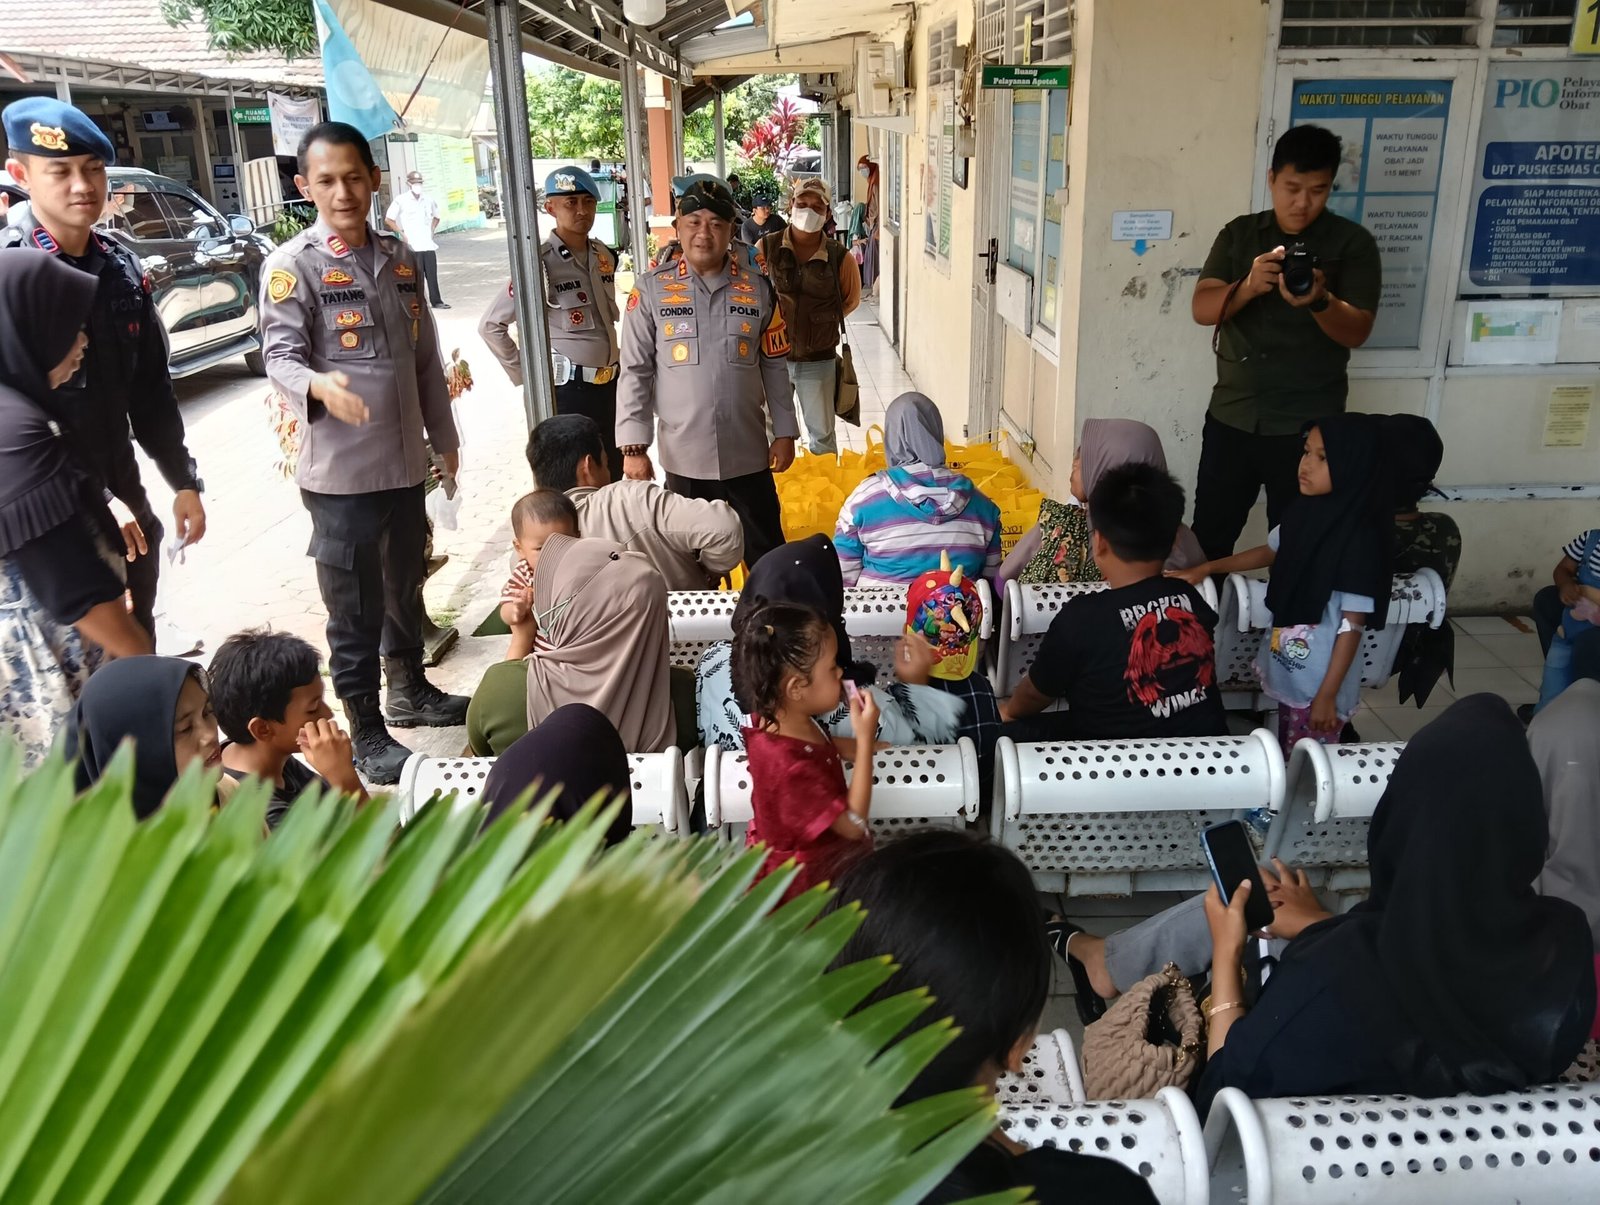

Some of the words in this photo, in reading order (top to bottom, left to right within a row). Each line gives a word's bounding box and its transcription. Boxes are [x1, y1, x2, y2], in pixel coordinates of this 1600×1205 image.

[1014, 68, 1038, 76] Ruang
[993, 78, 1030, 86] Pelayanan
[1032, 78, 1058, 86] Apotek
[1493, 78, 1560, 108] PIO
[1300, 94, 1336, 105] WAKTU
[1340, 94, 1382, 104] TUNGGU
[1385, 93, 1445, 104] PELAYANAN
[1560, 100, 1590, 110] Obat
[1492, 164, 1516, 176] UPT
[1518, 164, 1590, 175] PUSKESMAS
[1523, 189, 1545, 198] SIAP
[1485, 199, 1537, 207] PELAYANAN
[1506, 207, 1541, 216] KEPADA
[320, 288, 366, 304] TATANG
[660, 306, 694, 317] CONDRO
[730, 305, 760, 318] POLRI
